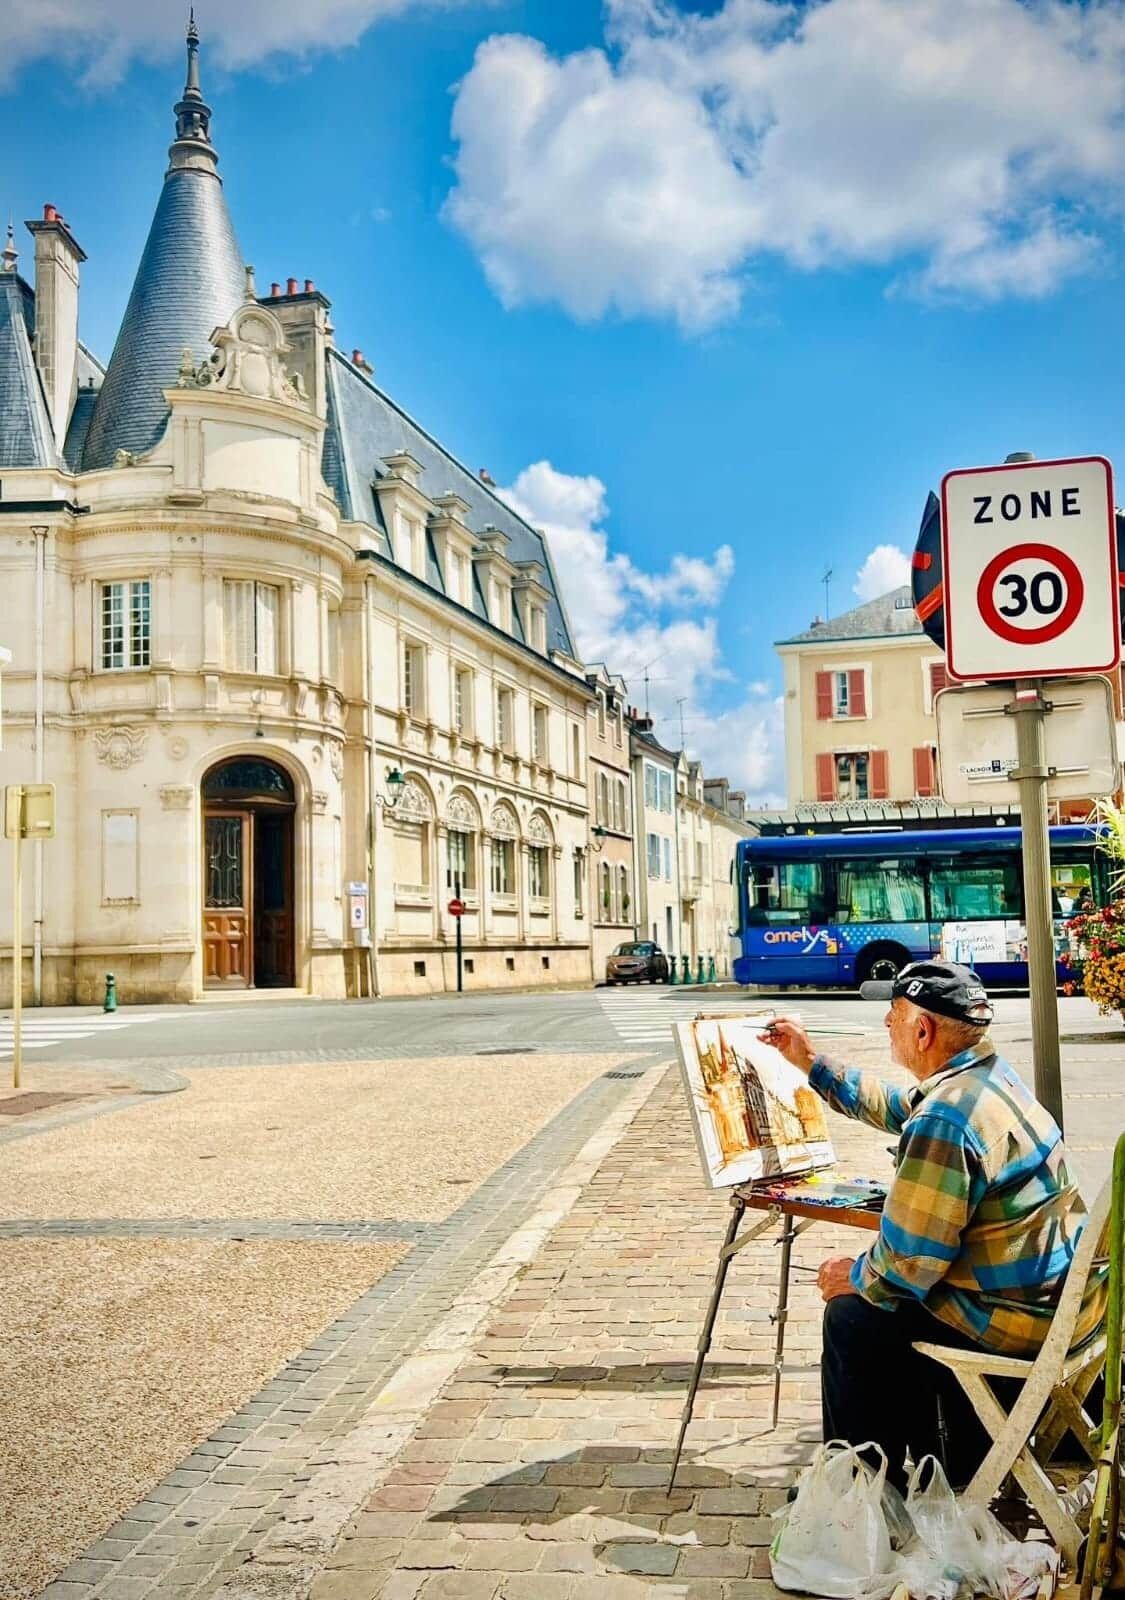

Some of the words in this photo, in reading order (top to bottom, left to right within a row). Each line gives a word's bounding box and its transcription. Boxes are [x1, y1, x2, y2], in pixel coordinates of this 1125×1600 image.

[973, 487, 1081, 524] ZONE
[999, 571, 1063, 617] 30
[764, 926, 829, 953] amelys
